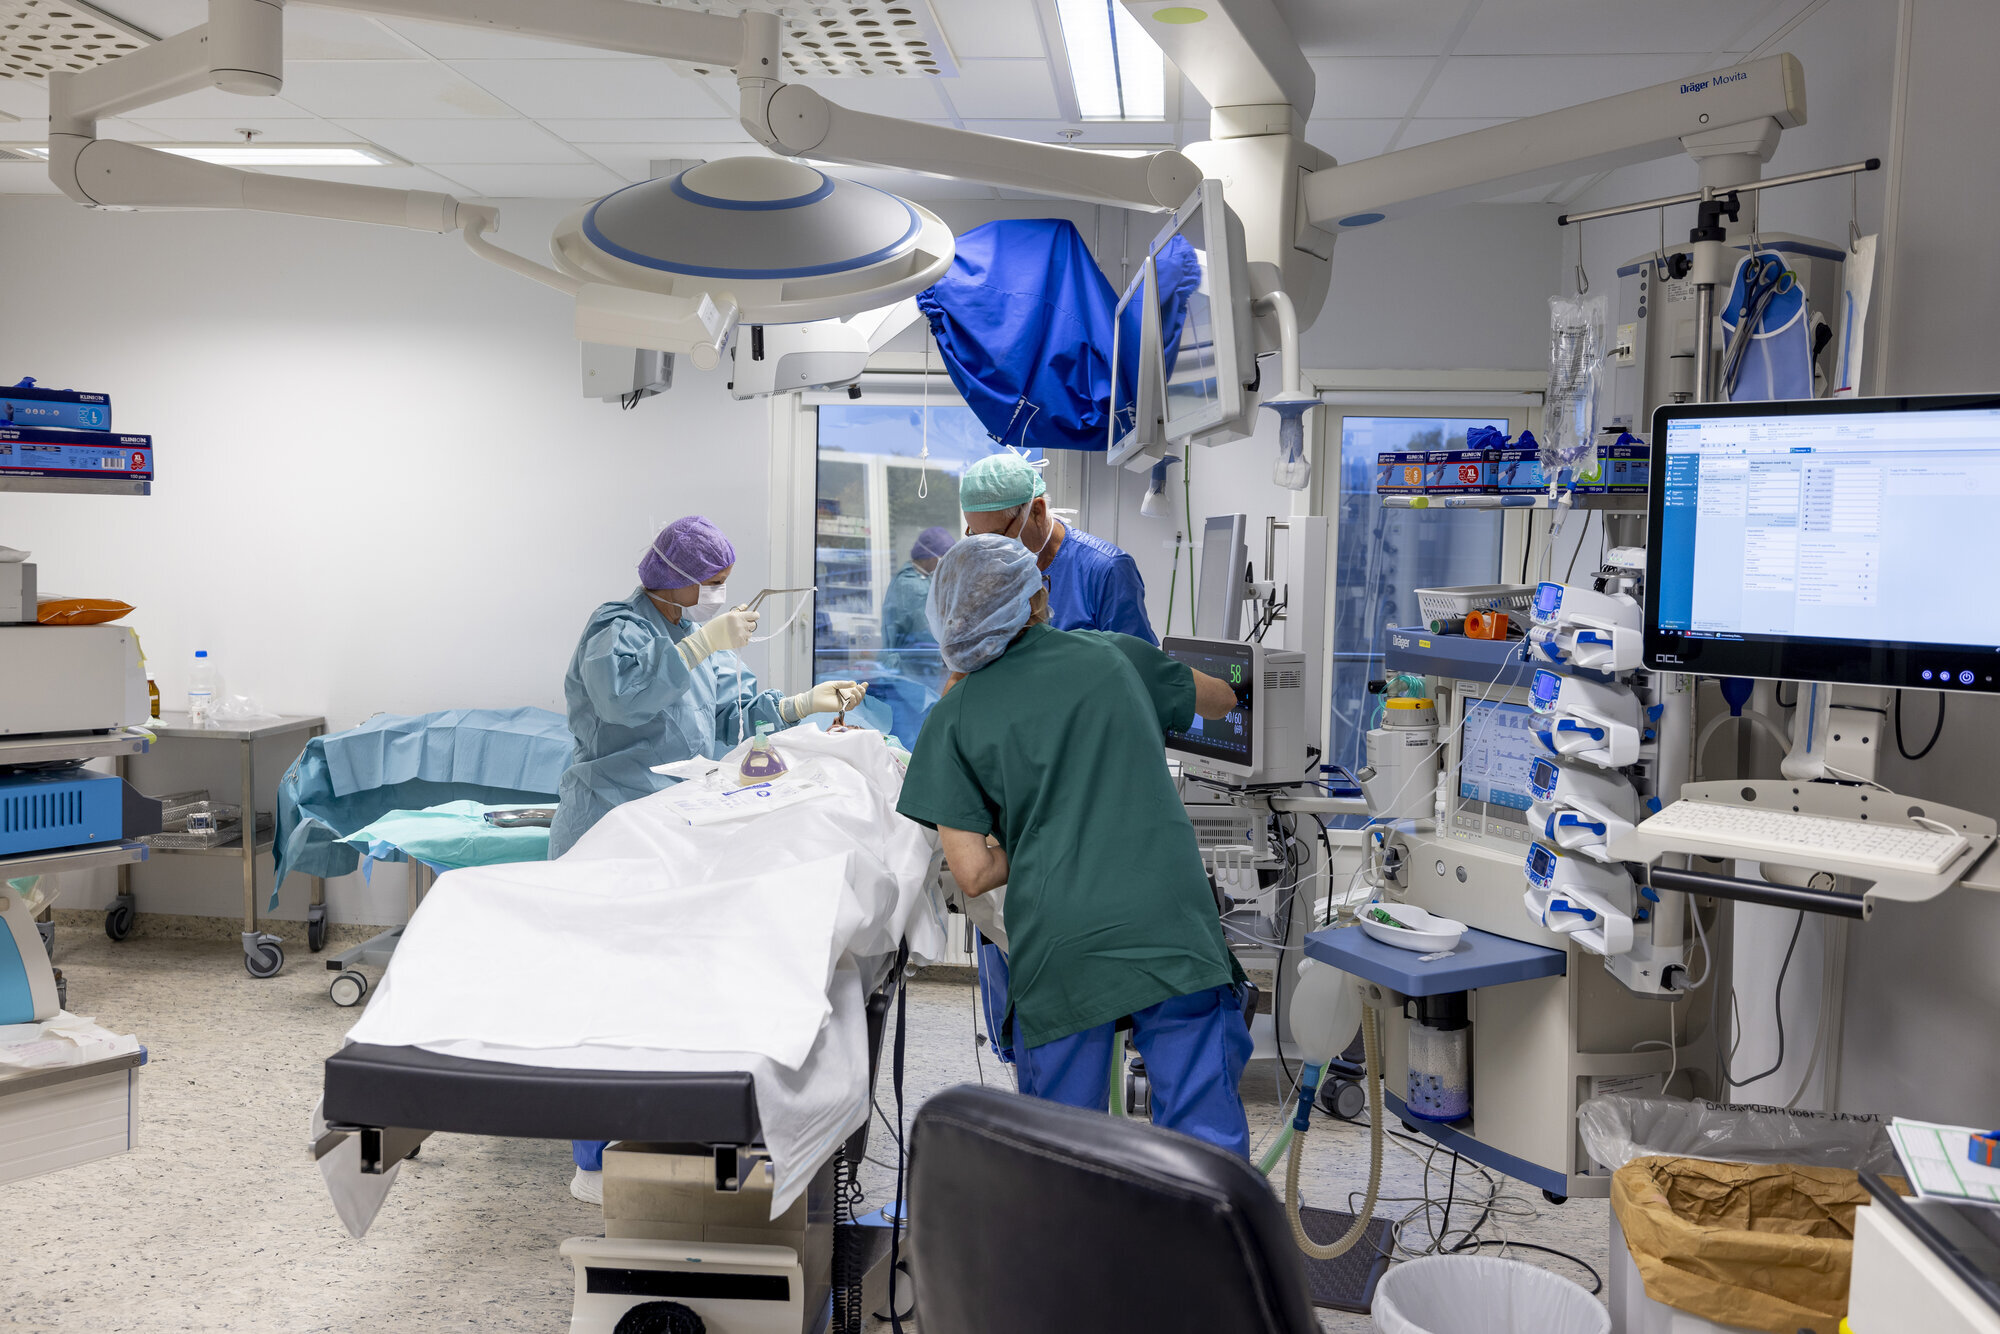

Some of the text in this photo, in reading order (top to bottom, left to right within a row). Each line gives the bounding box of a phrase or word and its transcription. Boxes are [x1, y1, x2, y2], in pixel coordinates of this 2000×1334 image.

[1680, 71, 1748, 94] Dräger Movita
[92, 411, 98, 419] L
[1413, 470, 1418, 478] S
[1467, 468, 1476, 477] XL
[1392, 634, 1410, 650] Dräger
[1230, 663, 1242, 684] 58
